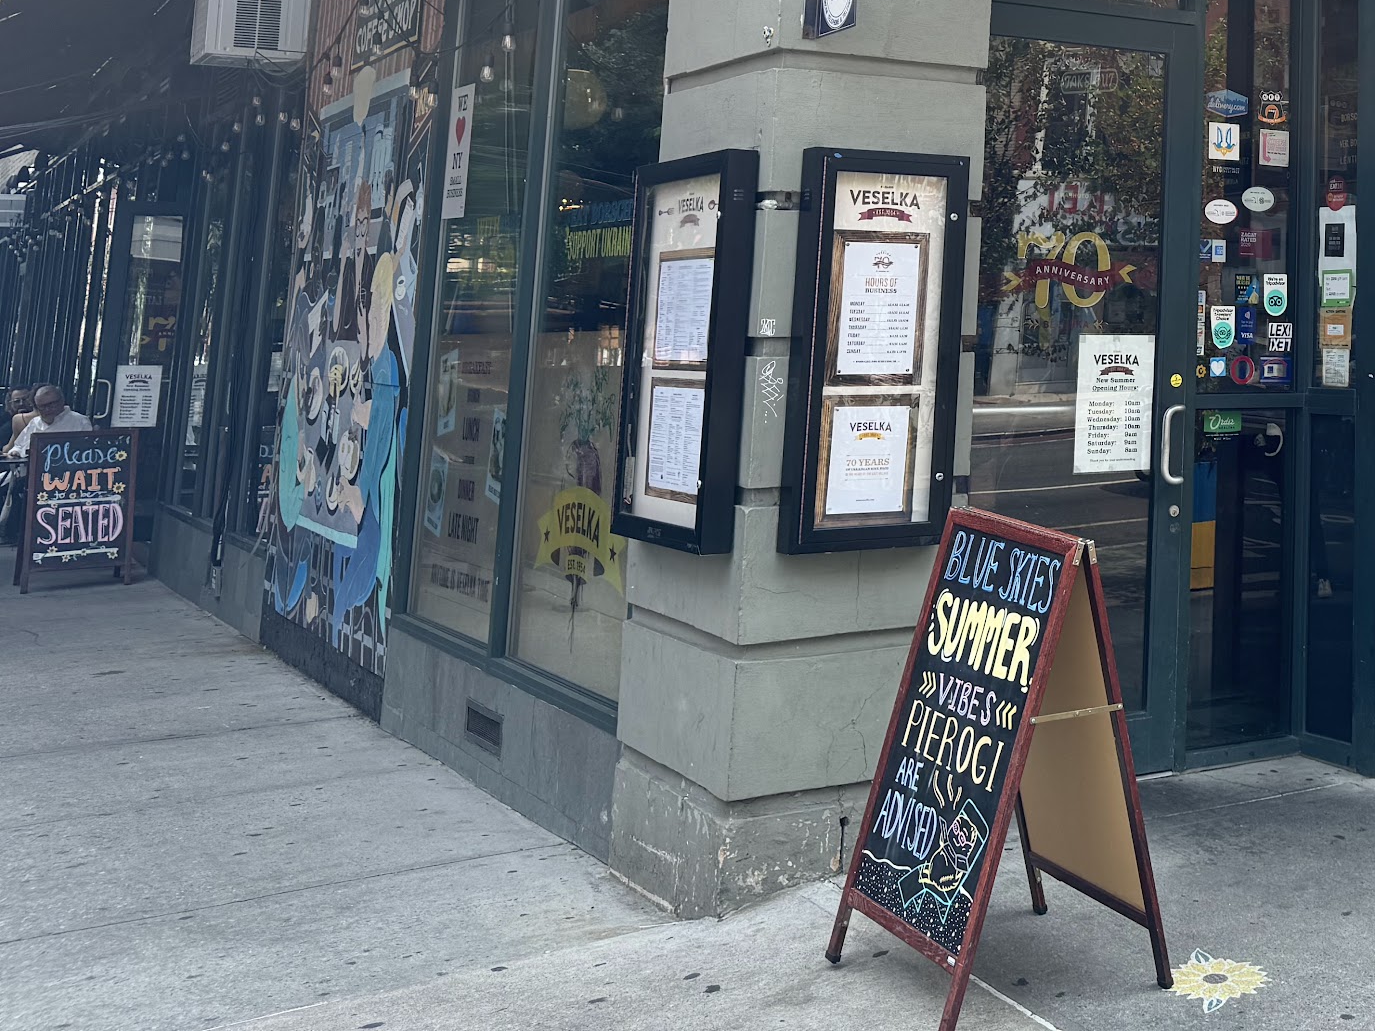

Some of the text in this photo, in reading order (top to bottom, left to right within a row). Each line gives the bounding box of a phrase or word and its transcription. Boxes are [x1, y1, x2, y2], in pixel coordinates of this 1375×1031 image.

[457, 94, 468, 112] WE
[1207, 97, 1246, 114] delivery.com
[452, 152, 463, 170] NY
[678, 196, 704, 214] VESELKA
[850, 189, 920, 209] VESELKA
[567, 229, 600, 260] SUPPORT
[1017, 231, 1111, 308] 70
[1036, 265, 1110, 286] ANNIVERSARY
[865, 277, 898, 287] HOURS OF
[1269, 324, 1292, 336] LEXI
[1094, 354, 1140, 366] VESELKA
[1092, 385, 1118, 393] Opening
[462, 417, 480, 442] LUNCH
[850, 421, 892, 432] VESELKA
[41, 441, 118, 471] Please
[858, 458, 890, 467] YEARS
[42, 467, 121, 491] WAIT
[458, 479, 475, 502] DINNER
[54, 490, 66, 499] to
[36, 503, 124, 544] SEATED
[448, 512, 480, 545] LATE NIGHT
[557, 501, 600, 549] VESELKA
[567, 559, 586, 575] EST. 1954
[944, 530, 1062, 614] BLUE SKIES
[927, 591, 1036, 687] SUMMER
[938, 673, 997, 727] VIBES
[901, 699, 1005, 792] PIEROGI
[894, 756, 925, 792] ARE
[873, 788, 938, 861] ADVISED
